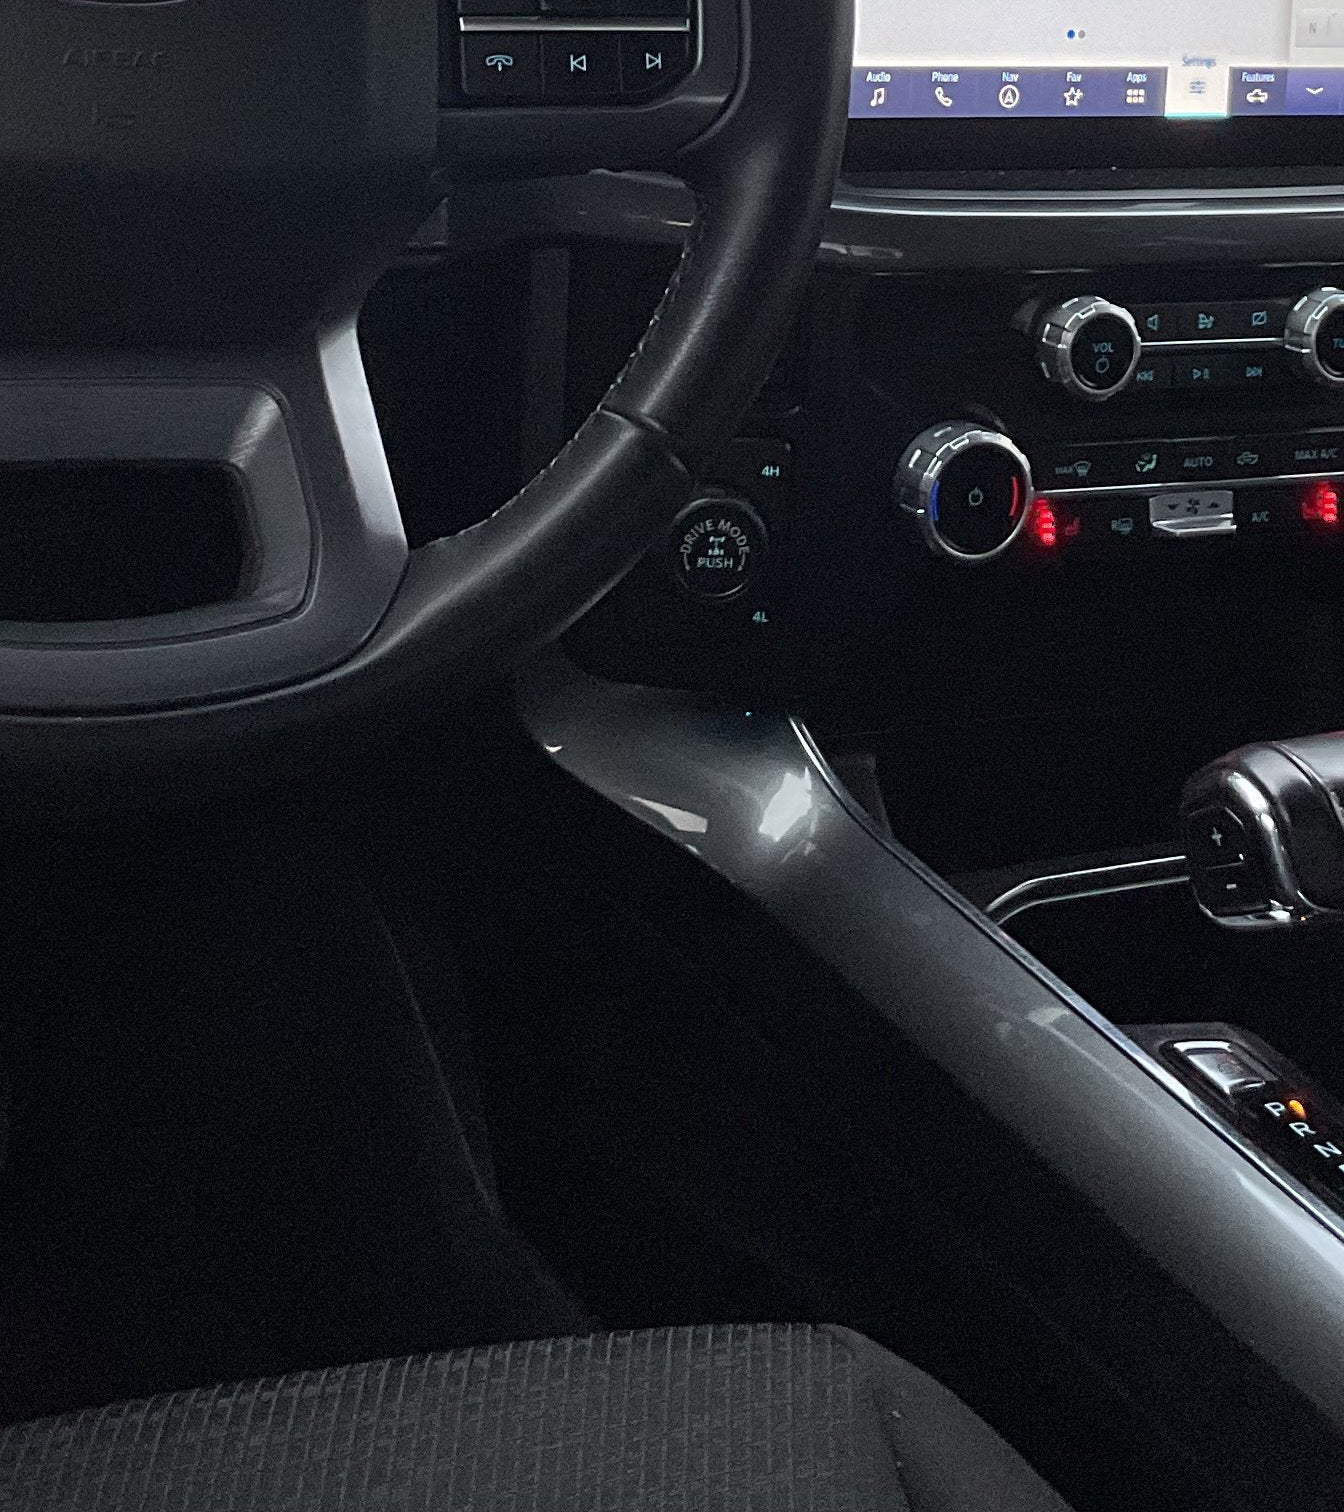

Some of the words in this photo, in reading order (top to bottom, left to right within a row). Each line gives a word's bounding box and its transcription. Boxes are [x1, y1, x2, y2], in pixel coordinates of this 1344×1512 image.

[1308, 22, 1317, 34] N
[1182, 56, 1217, 69] Settings
[866, 71, 892, 83] Audio
[931, 71, 959, 83] Phone
[1002, 71, 1019, 83] Nav
[1066, 71, 1082, 83] Fav
[1126, 72, 1148, 84] Apps
[1241, 71, 1275, 83] Features
[1092, 342, 1114, 354] VOL
[1295, 449, 1318, 461] MAX
[1184, 456, 1213, 468] AUTO
[762, 465, 780, 477] 4H
[680, 519, 715, 554] DRIVE
[717, 519, 750, 556] MODE
[697, 557, 733, 569] PUSH
[752, 611, 769, 623] 4L
[1264, 1101, 1286, 1117] P
[1289, 1121, 1316, 1138] R
[1313, 1141, 1342, 1158] N
